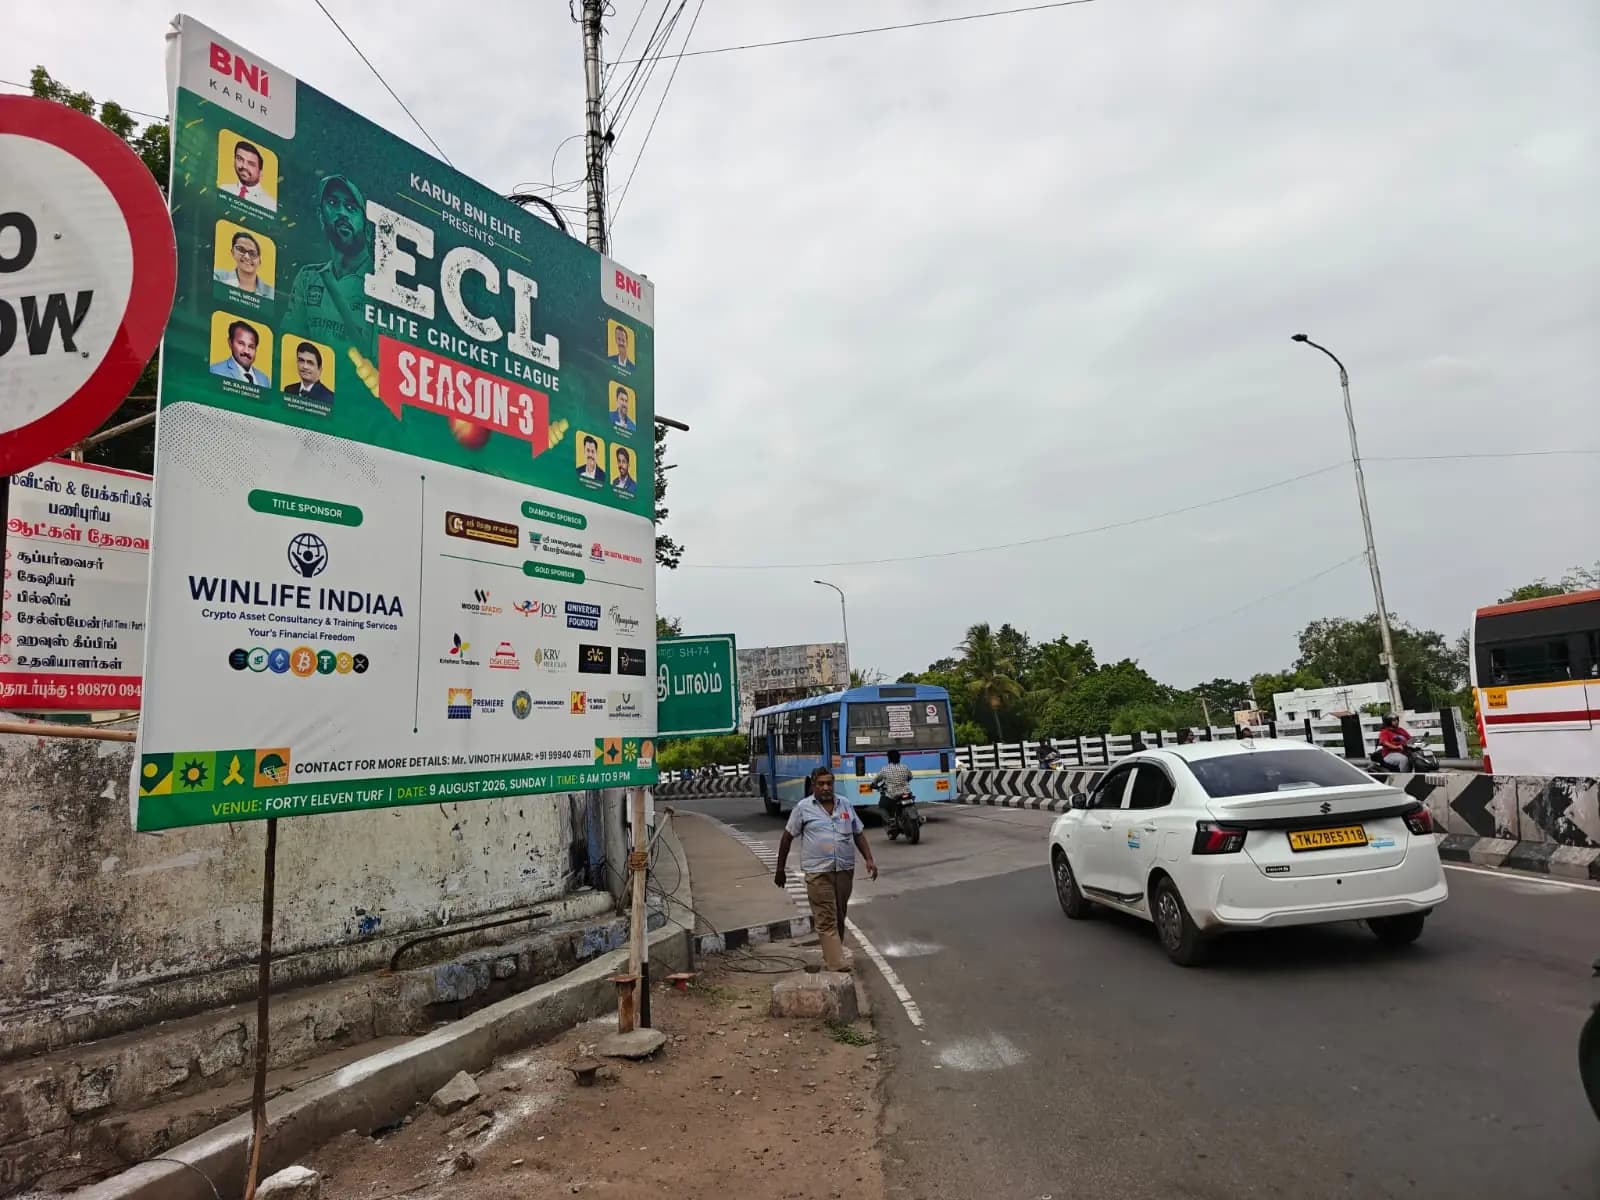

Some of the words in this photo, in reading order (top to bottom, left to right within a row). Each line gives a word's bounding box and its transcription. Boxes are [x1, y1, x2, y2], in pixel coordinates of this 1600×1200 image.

[209, 78, 268, 116] KARUR
[410, 173, 460, 213] KARUR
[464, 200, 487, 226] BNI
[490, 213, 522, 245] ELITE
[442, 212, 495, 247] PRESENTS
[364, 199, 560, 370] ECL
[364, 304, 418, 340] ELITE
[427, 327, 499, 368] CRICKET
[505, 357, 560, 392] LEAGUE
[398, 350, 535, 435] SEASON-3
[66, 481, 77, 496] &
[272, 498, 296, 512] TITLE
[298, 503, 343, 519] SPONSOR
[529, 506, 556, 520] DIAMOND
[556, 512, 582, 526] SPONSOR
[8, 517, 82, 543] ஆட்கள்
[87, 528, 151, 551] தேவை
[535, 565, 550, 575] GOLD
[550, 568, 575, 579] SPONSOR
[188, 575, 311, 610] WINLIFE
[319, 588, 404, 617] INDIAA
[461, 602, 480, 611] WOOD
[201, 608, 237, 621] Crypto
[239, 610, 266, 622] Asset
[268, 613, 323, 627] Consultancy
[325, 617, 332, 626] &
[333, 617, 365, 630] Training
[366, 620, 398, 631] Services
[540, 602, 558, 617] JOY
[567, 603, 600, 615] UNIVERSAL
[568, 617, 597, 629] FOUNDRY
[248, 627, 277, 639] Your's
[279, 628, 318, 640] Financial
[319, 631, 356, 643] Freedom
[543, 648, 561, 660] KRV
[679, 645, 710, 658] SH-74
[77, 683, 116, 697] 90870
[657, 664, 670, 702] தி
[674, 662, 722, 695] பாலம்
[472, 698, 505, 709] PREMIERE
[295, 759, 353, 774] CONTACT
[355, 759, 375, 771] FOR
[378, 757, 407, 769] MORE
[409, 755, 450, 768] DETAILS:
[451, 755, 466, 765] Mr.
[468, 753, 501, 765] VINOTH
[502, 751, 534, 763] KUMAR:
[534, 751, 547, 761] +91
[548, 750, 572, 761] 99940
[212, 799, 262, 816] VENUE:
[265, 795, 309, 811] FORTY
[311, 791, 353, 807] ELEVEN
[356, 789, 384, 802] TURF
[397, 787, 427, 799] DATE:
[429, 784, 436, 796] 9
[438, 781, 481, 796] AUGUST
[482, 779, 508, 793] 2026,
[510, 776, 547, 790] SUNDAY
[557, 774, 578, 785] TIME:
[579, 774, 585, 784] 6
[586, 773, 600, 783] AM
[601, 772, 612, 782] TO
[612, 772, 618, 782] 9
[619, 771, 631, 781] PM
